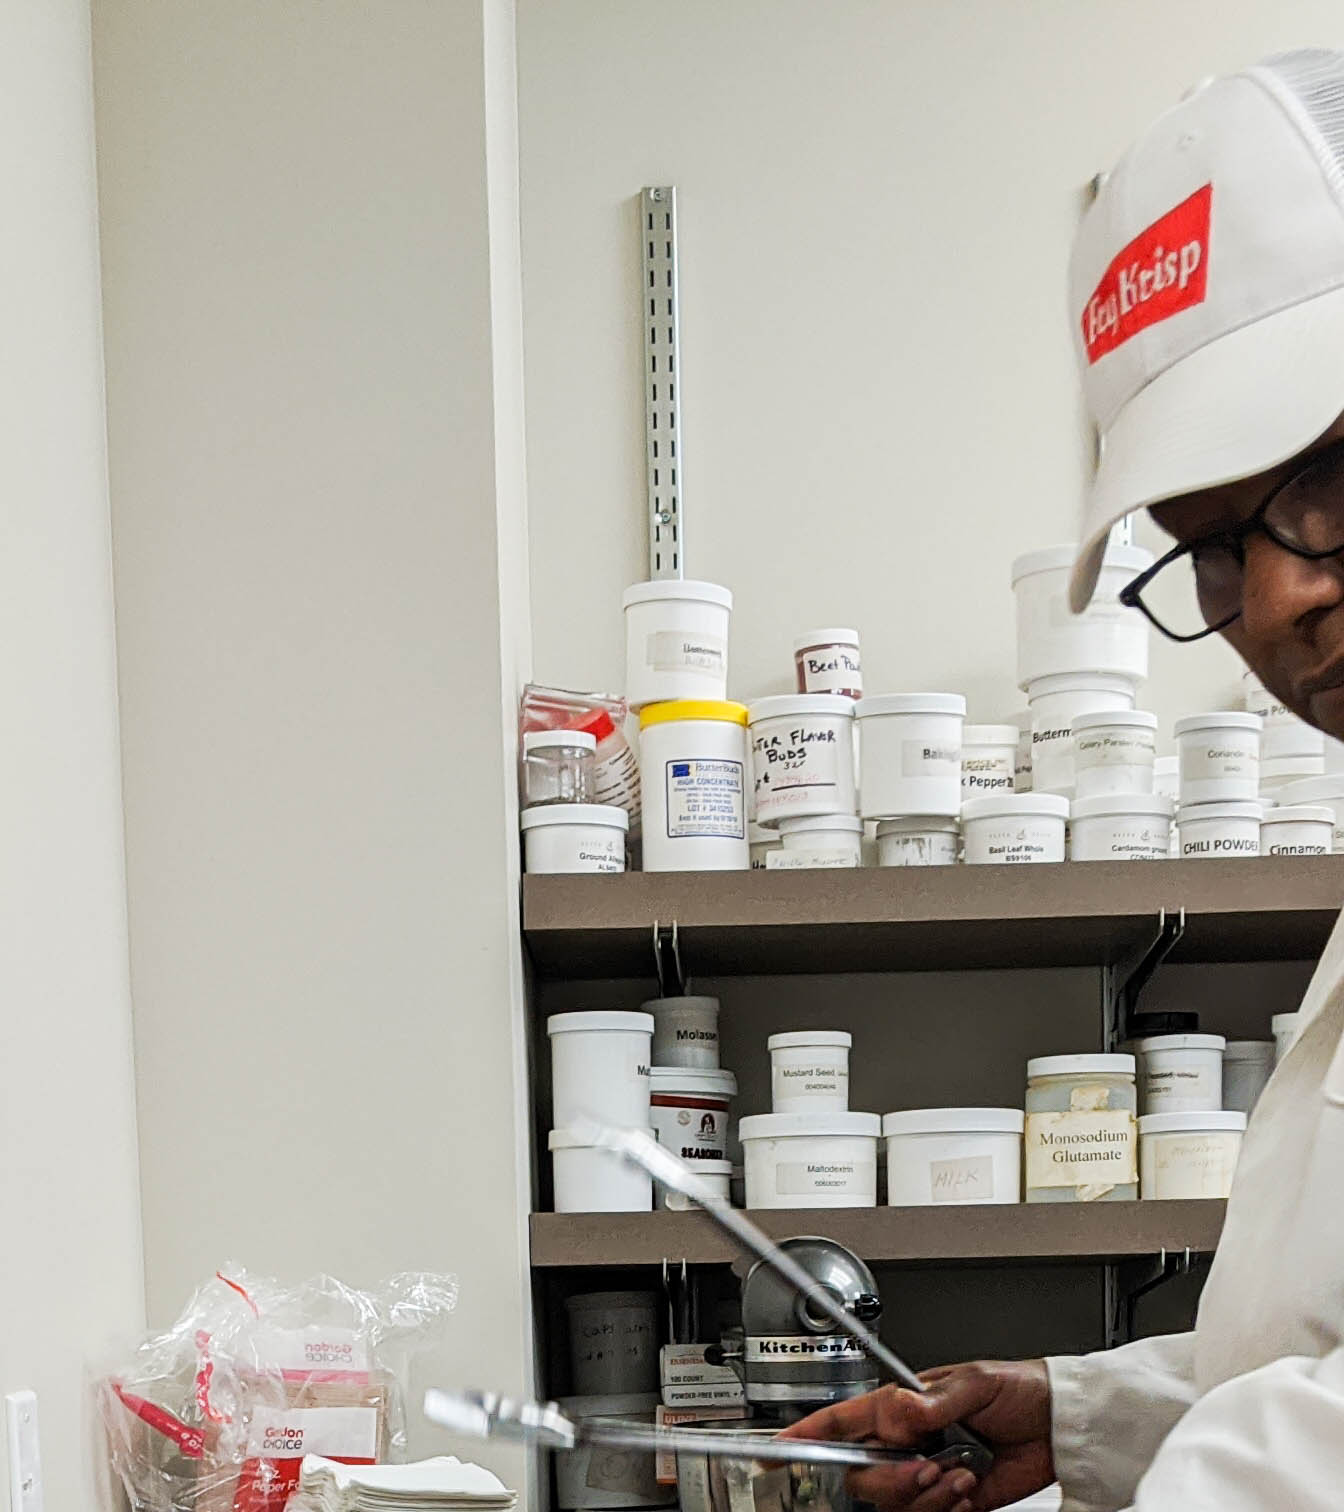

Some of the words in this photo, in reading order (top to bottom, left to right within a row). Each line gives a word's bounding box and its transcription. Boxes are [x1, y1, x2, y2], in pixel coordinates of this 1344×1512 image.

[808, 659, 838, 675] Beet
[1183, 840, 1211, 855] CHILI
[1040, 1128, 1129, 1146] Monosodium
[1052, 1147, 1123, 1164] Glutamate
